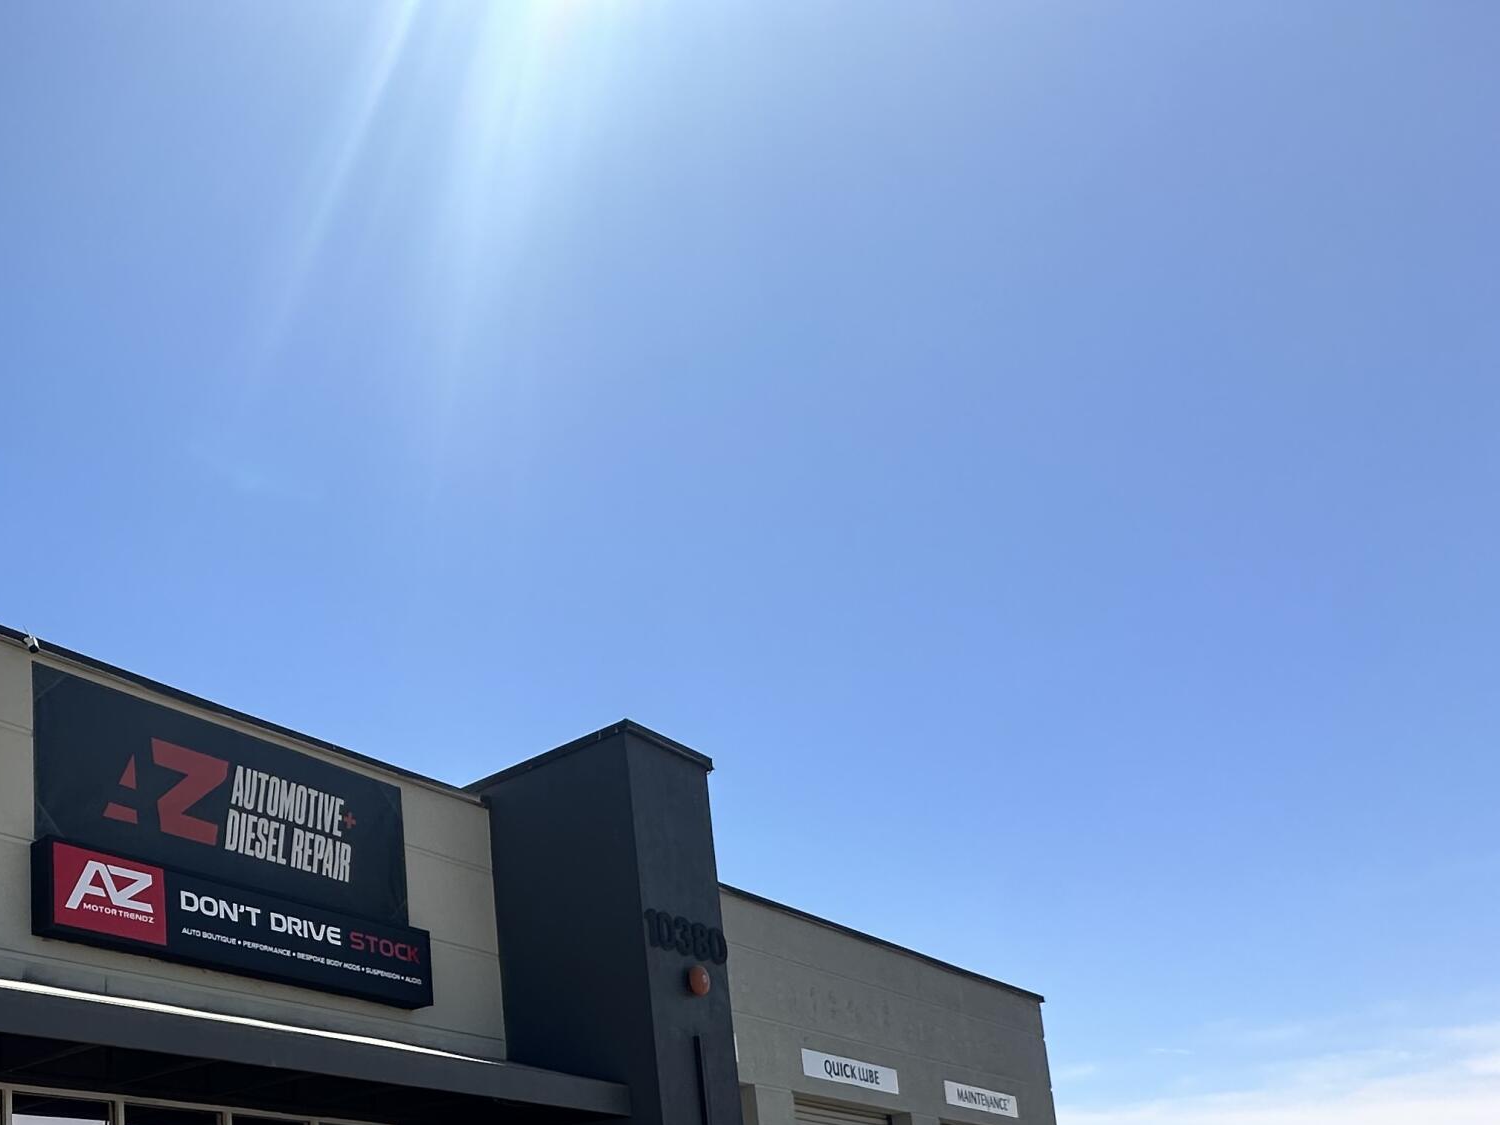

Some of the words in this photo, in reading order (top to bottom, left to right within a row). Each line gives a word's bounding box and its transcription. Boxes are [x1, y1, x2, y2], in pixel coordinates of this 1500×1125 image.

[225, 808, 287, 865] DIESEL
[290, 827, 352, 883] REPAIR
[65, 860, 154, 914] AZ
[180, 890, 261, 927] DON'T
[270, 912, 342, 946] DRIVE
[350, 932, 421, 965] STOCK
[181, 927, 201, 937] AUTO
[202, 931, 237, 946] BOUTIQUE
[242, 940, 292, 957] PERFORMANCE
[644, 908, 728, 965] 10380
[824, 1059, 857, 1080] QUICK
[858, 1068, 880, 1085] LUBE
